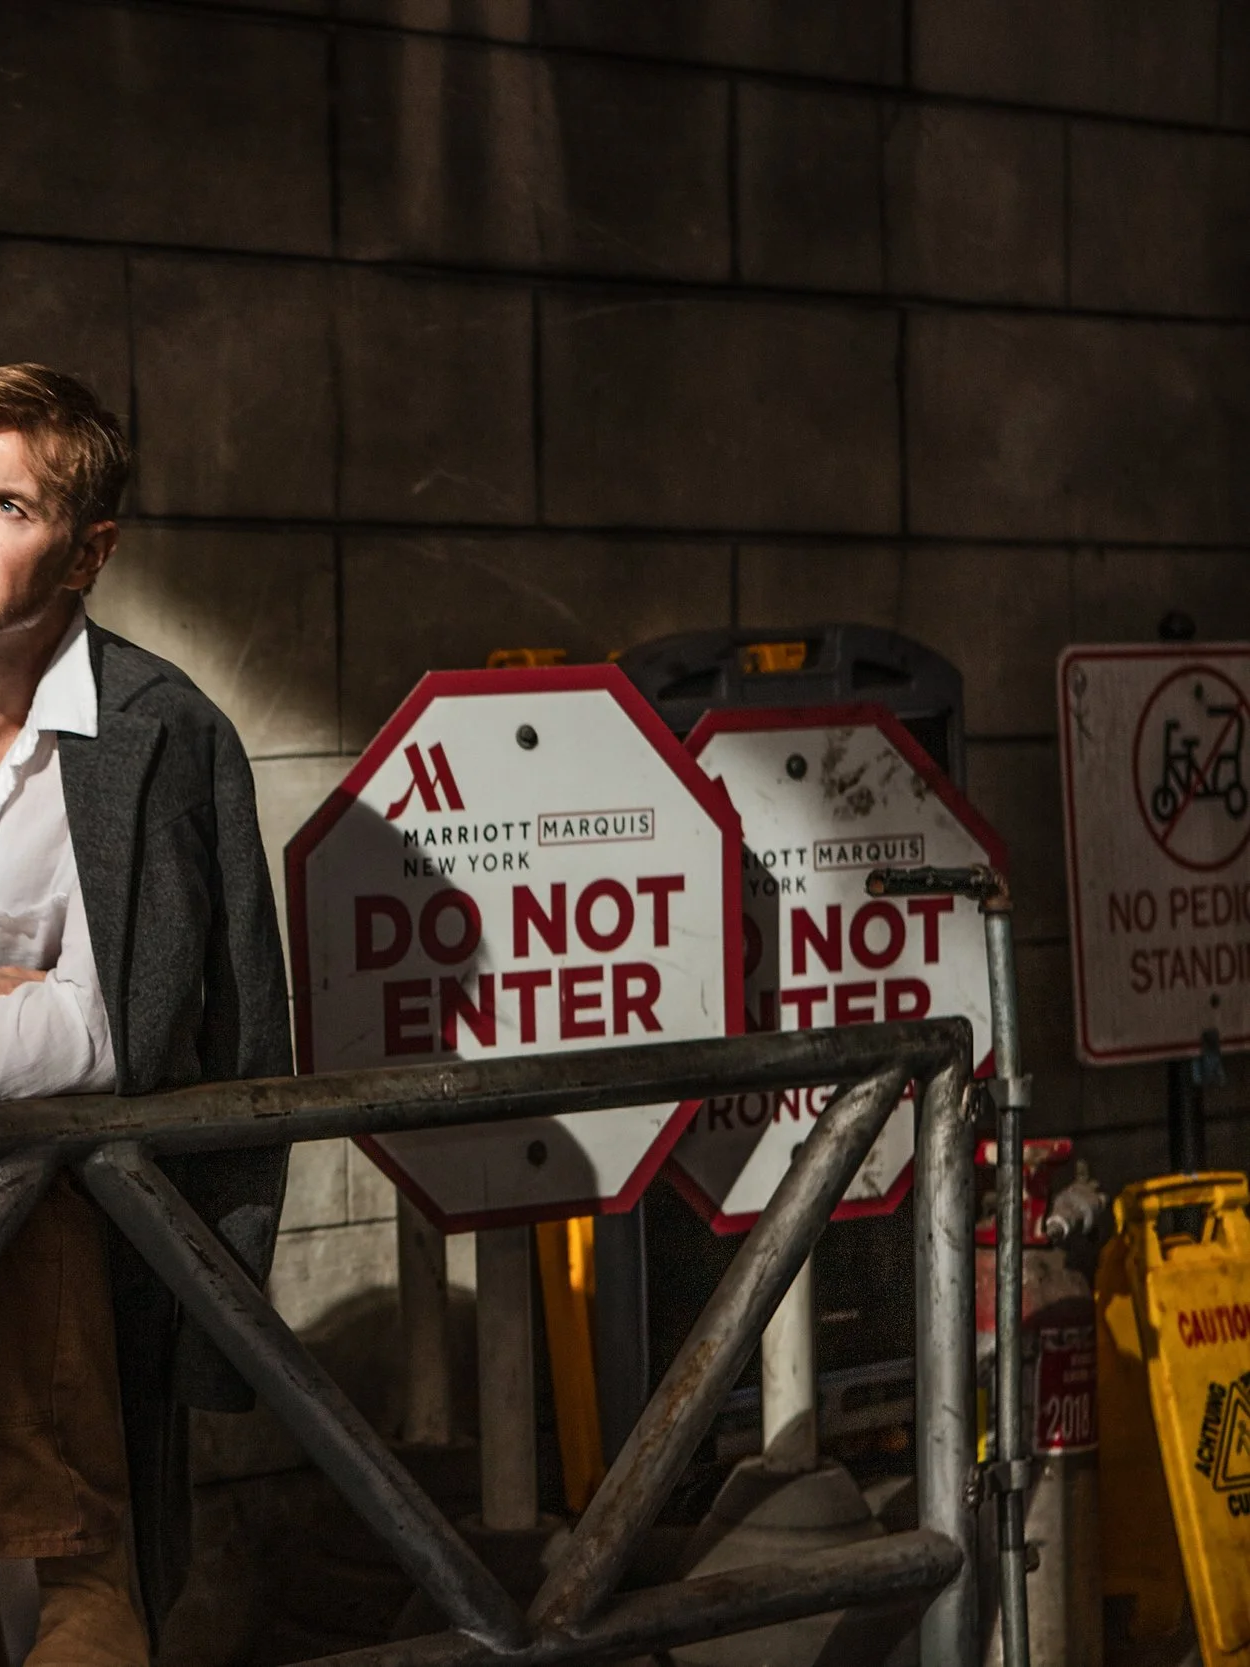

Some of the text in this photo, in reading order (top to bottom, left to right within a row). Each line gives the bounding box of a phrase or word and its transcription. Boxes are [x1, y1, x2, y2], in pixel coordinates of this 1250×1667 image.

[403, 815, 651, 848] MARRIOTT MARQUIS
[818, 841, 921, 864] MARQUIS
[404, 851, 531, 878] NEW YORK
[749, 876, 807, 898] YORK
[355, 890, 483, 972] DO
[512, 875, 686, 960] NOT
[1108, 889, 1158, 934] NO
[791, 896, 954, 976] NOT
[1130, 942, 1250, 994] STANDI
[384, 963, 663, 1057] ENTER
[687, 1086, 833, 1134] RONG
[1177, 1302, 1250, 1350] CAUTIO
[1042, 1393, 1091, 1442] 2018
[1194, 1381, 1226, 1479] ACHTUNG
